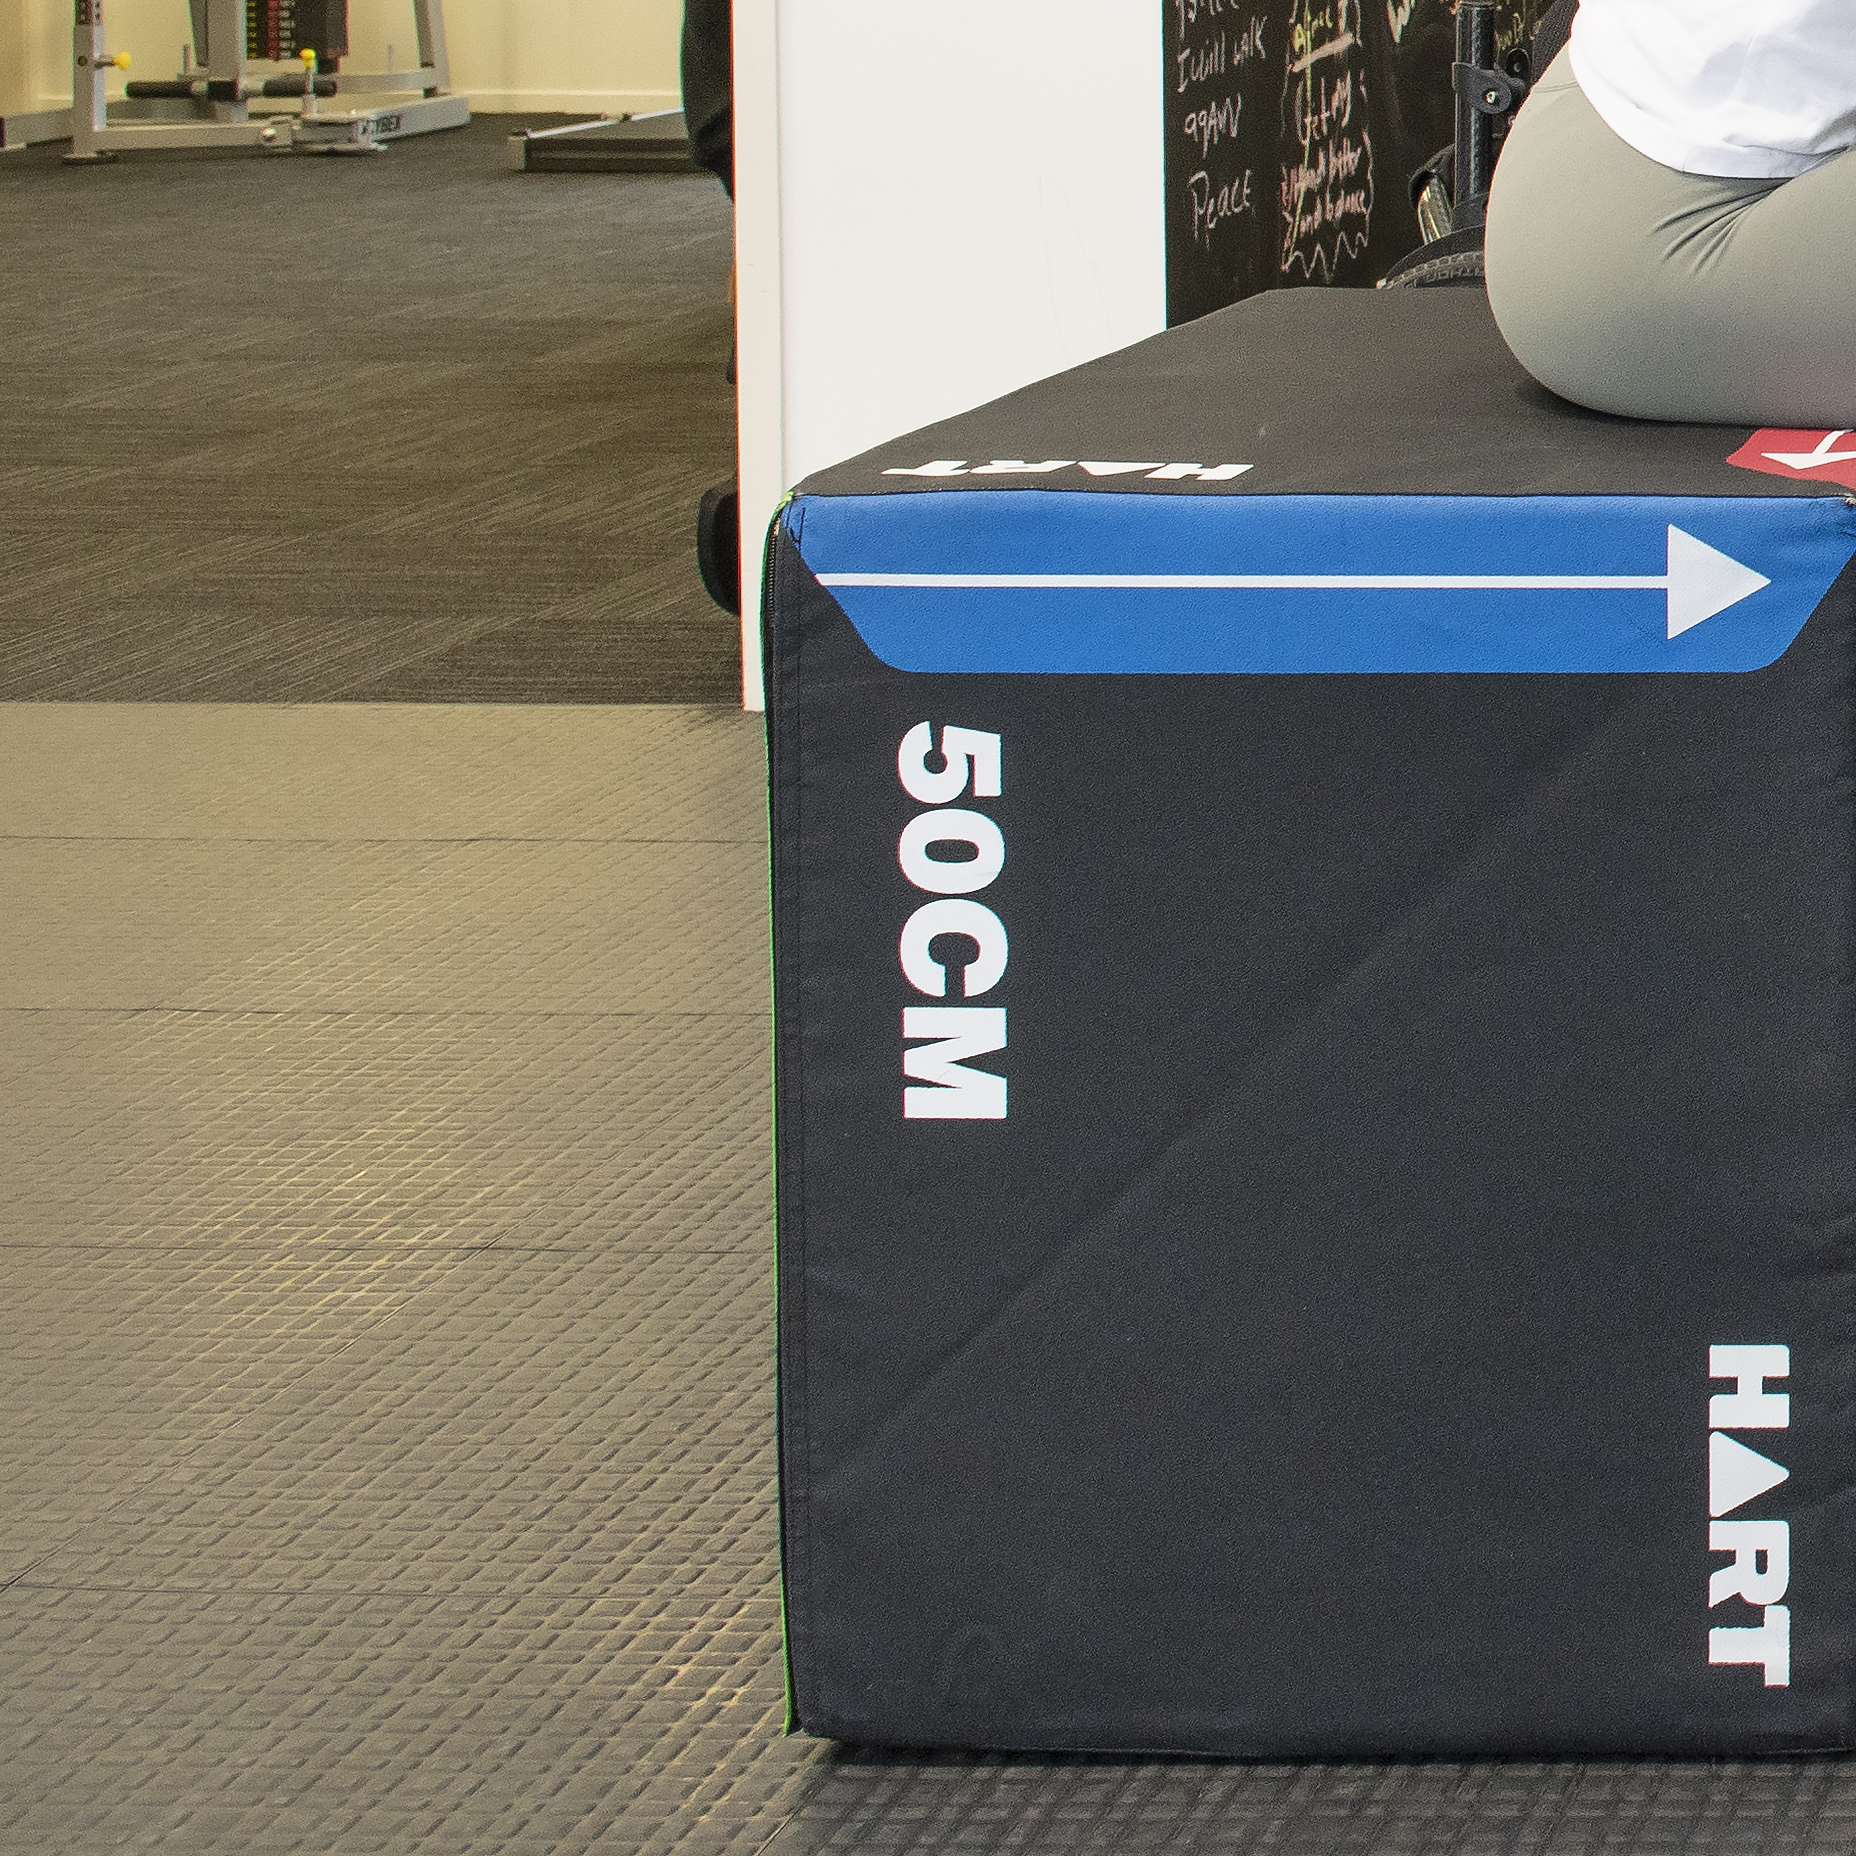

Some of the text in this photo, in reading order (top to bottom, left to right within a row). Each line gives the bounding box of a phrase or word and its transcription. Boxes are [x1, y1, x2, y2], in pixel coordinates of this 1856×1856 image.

[880, 459, 1255, 481] HART
[897, 719, 1009, 1121] 50CM
[1707, 1343, 1792, 1688] HART
